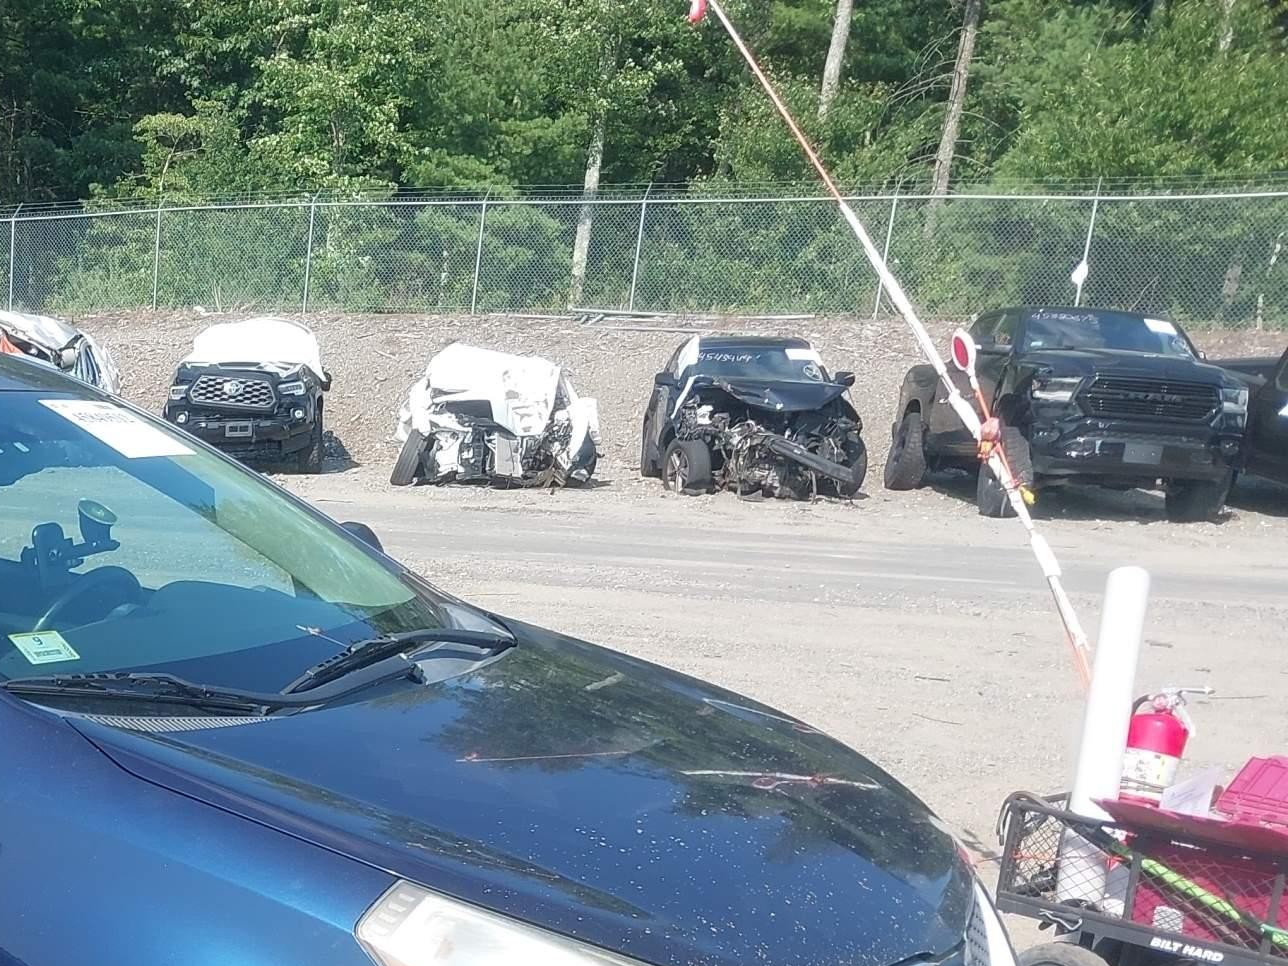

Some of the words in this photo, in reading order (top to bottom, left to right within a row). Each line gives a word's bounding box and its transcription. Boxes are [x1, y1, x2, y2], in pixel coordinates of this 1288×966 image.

[32, 635, 44, 646] 9
[1150, 936, 1183, 952] BILT
[1182, 943, 1225, 963] HARD
